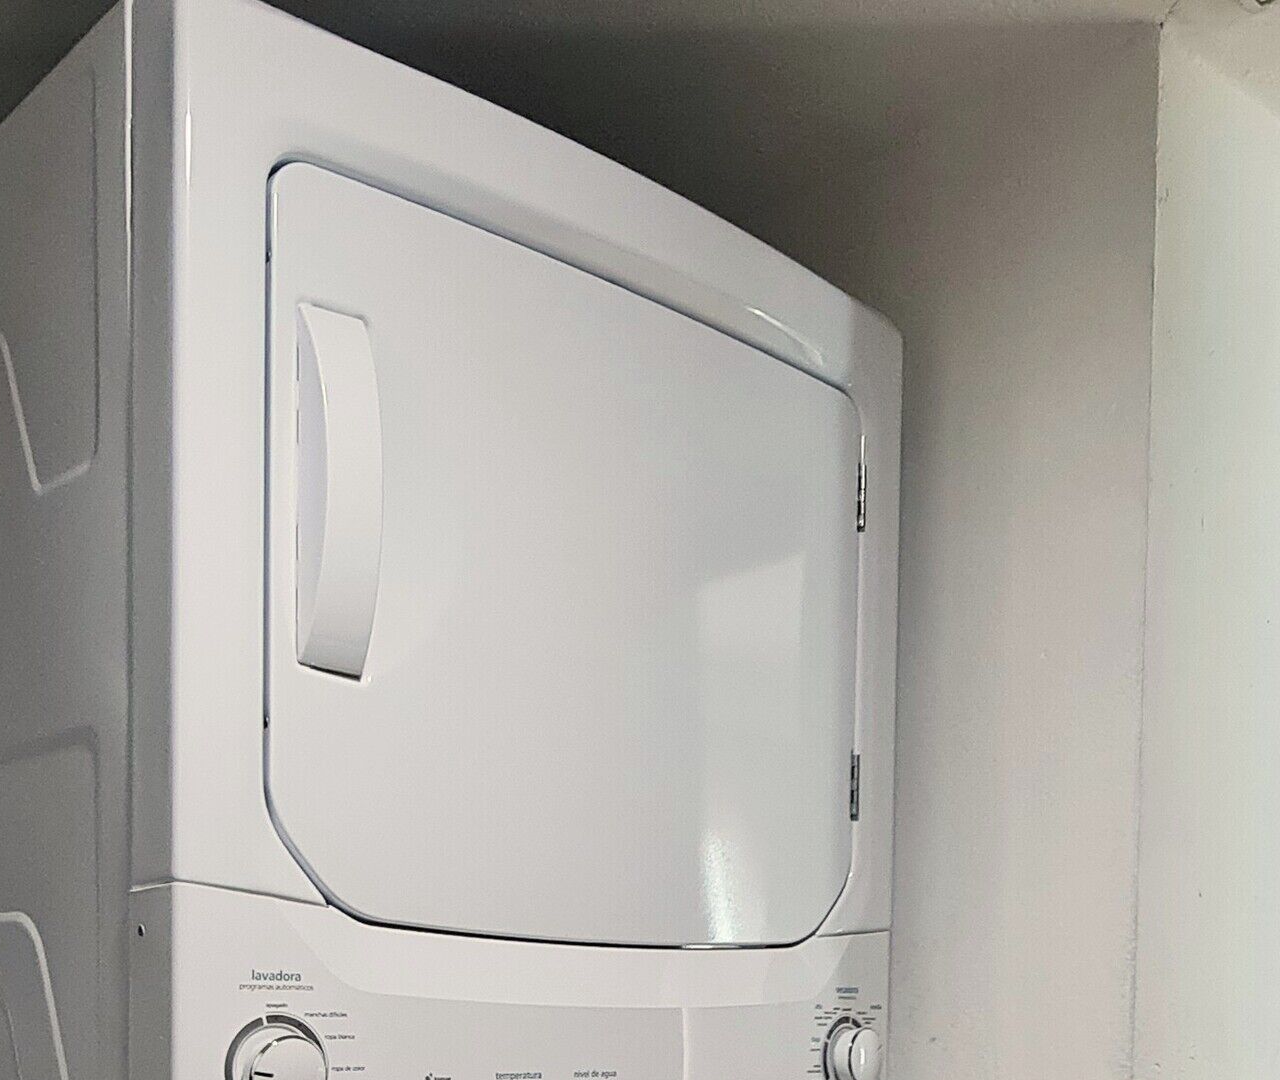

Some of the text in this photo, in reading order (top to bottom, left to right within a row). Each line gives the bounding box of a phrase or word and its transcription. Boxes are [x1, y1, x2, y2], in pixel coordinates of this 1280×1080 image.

[251, 969, 302, 982] lavadora
[238, 983, 274, 992] programas
[495, 1071, 542, 1080] temperatura
[573, 1070, 617, 1079] nivel de agua
